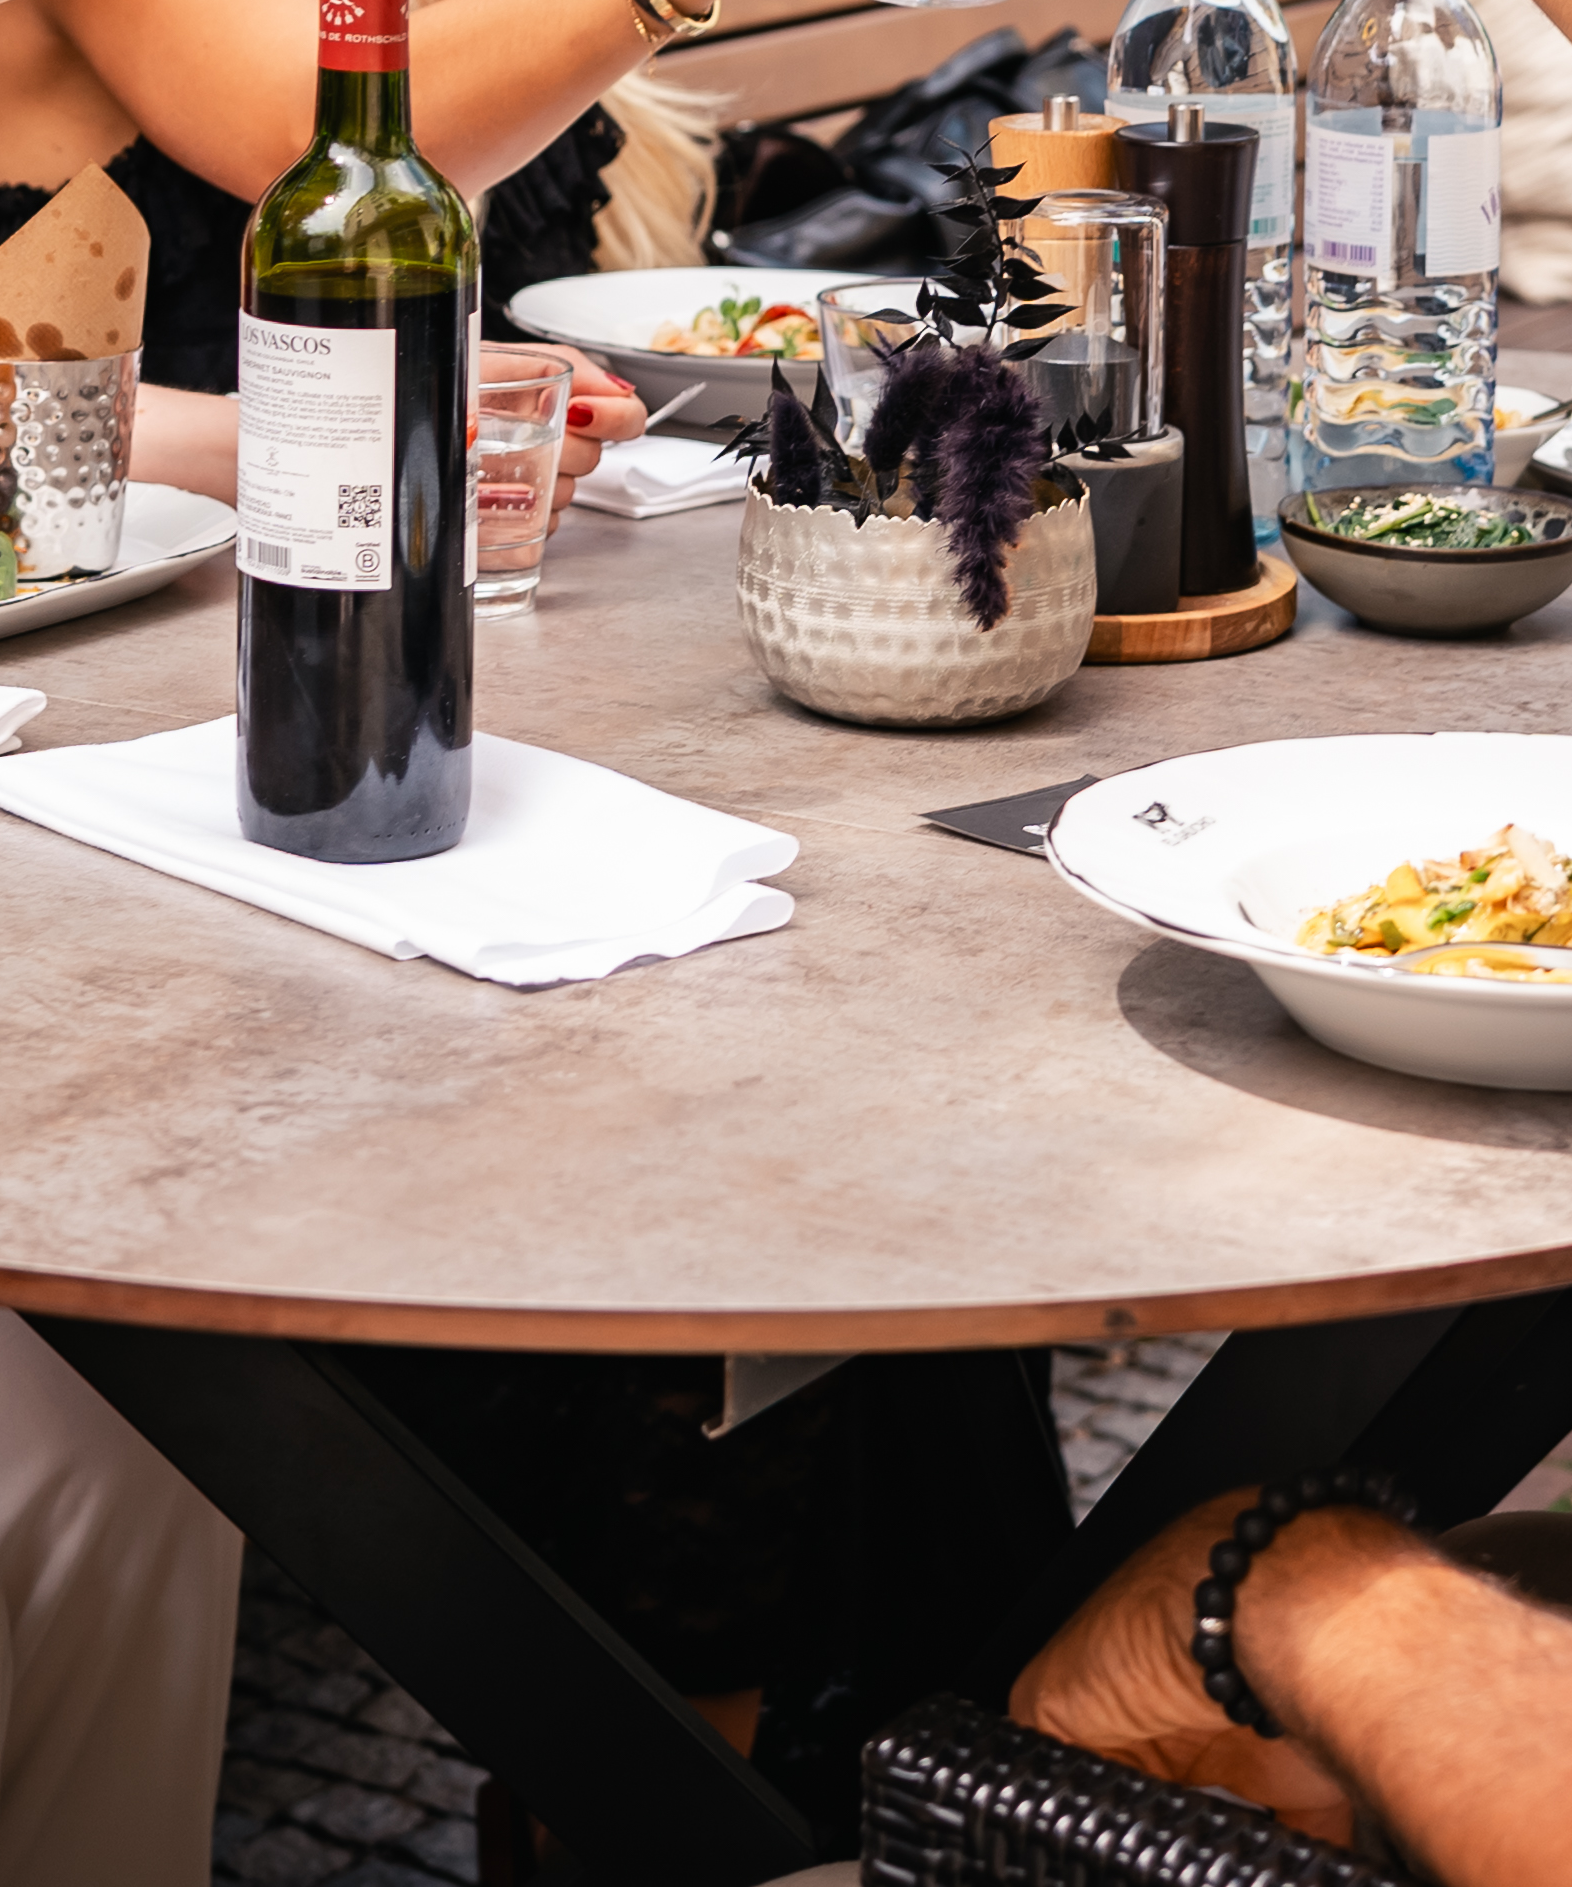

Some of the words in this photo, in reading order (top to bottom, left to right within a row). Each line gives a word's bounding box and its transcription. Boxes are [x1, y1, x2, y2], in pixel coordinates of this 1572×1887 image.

[328, 32, 341, 42] DE
[344, 32, 407, 44] ROTHSCHILD
[242, 322, 259, 345] LOS
[260, 329, 331, 356] VASCOS
[272, 365, 331, 381] SAUVIGNON
[361, 552, 374, 568] B
